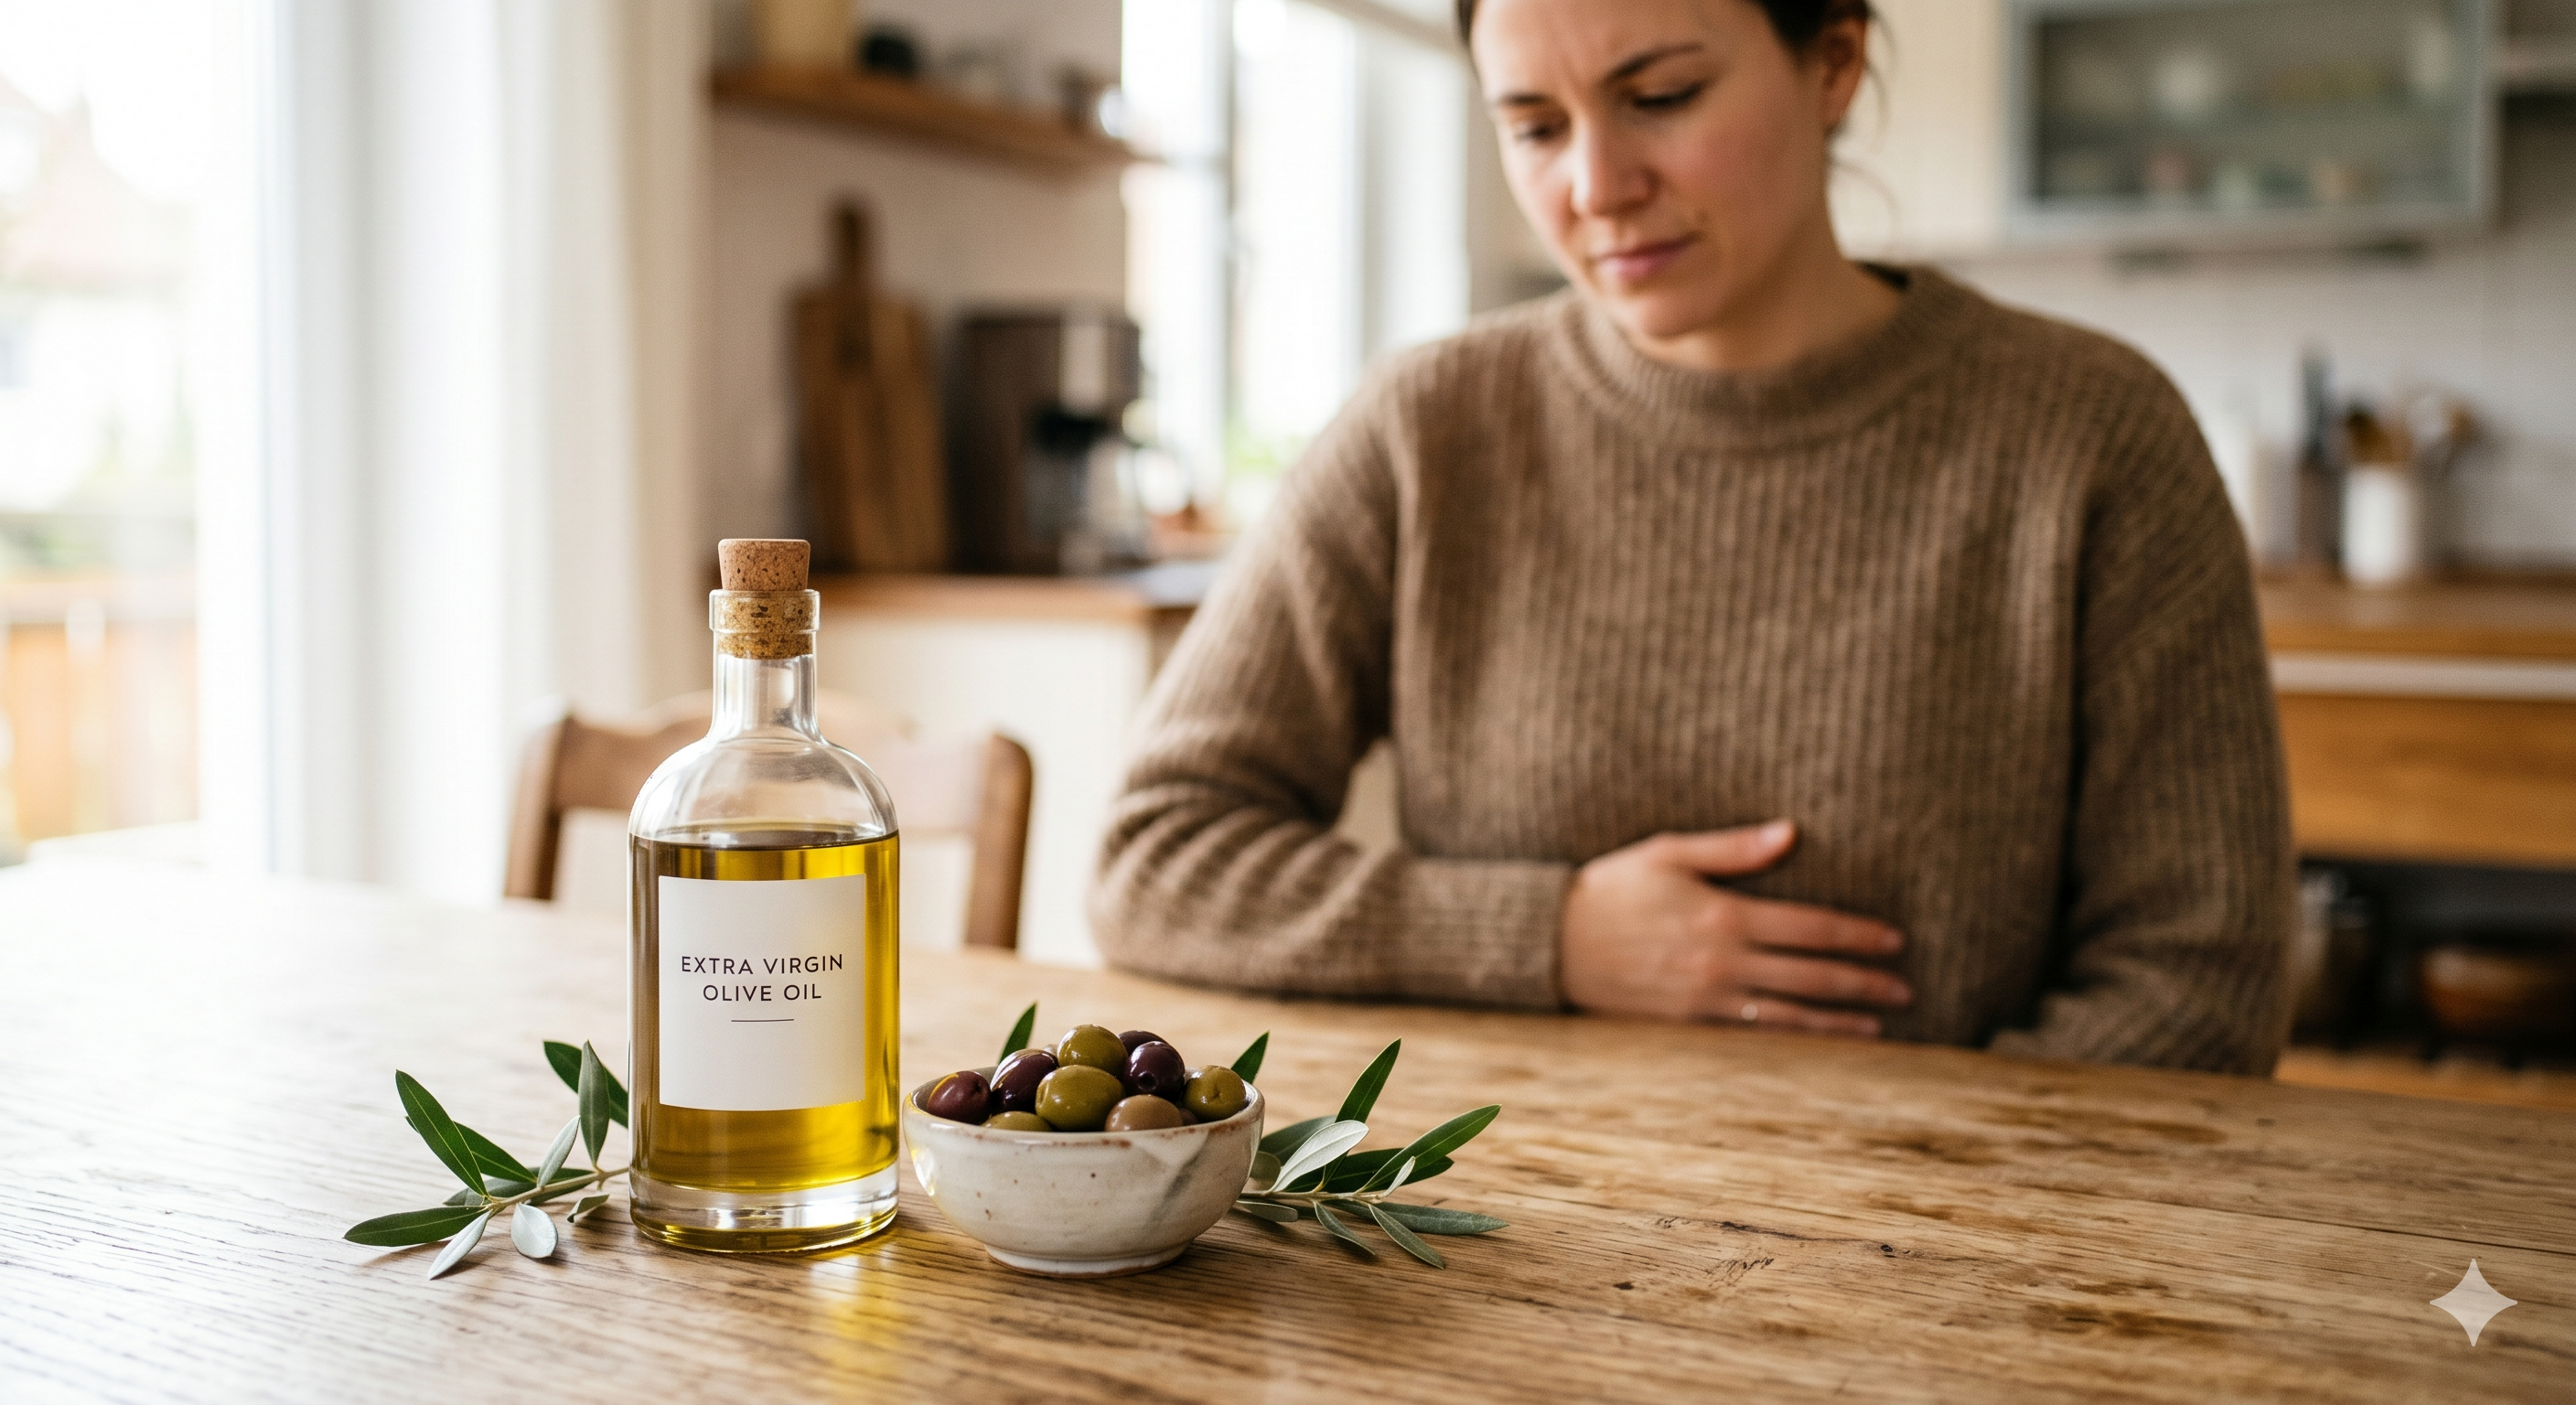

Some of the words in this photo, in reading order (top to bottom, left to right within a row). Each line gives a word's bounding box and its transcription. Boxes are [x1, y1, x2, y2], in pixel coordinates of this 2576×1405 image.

[682, 955, 754, 975] EXTRA
[762, 953, 843, 975] VIRGIN
[703, 984, 772, 1003] OLIVE
[783, 982, 822, 1002] OIL
